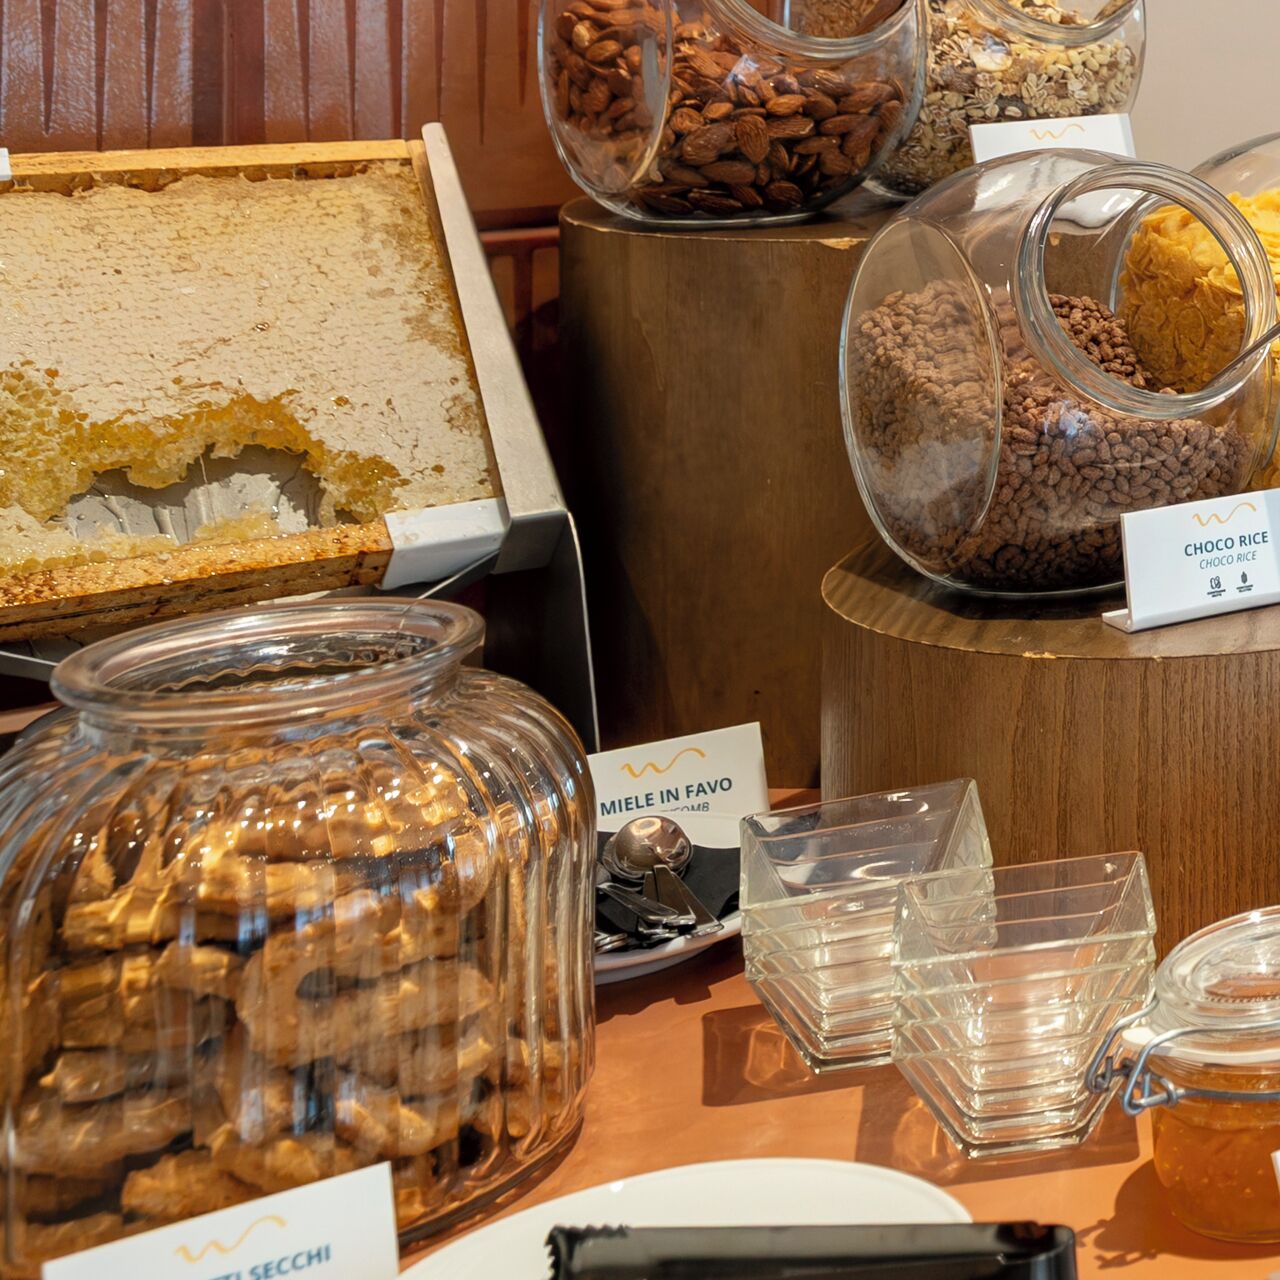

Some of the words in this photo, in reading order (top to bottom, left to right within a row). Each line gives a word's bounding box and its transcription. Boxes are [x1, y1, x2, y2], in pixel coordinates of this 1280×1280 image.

[1184, 537, 1235, 556] CHOCO
[1239, 531, 1269, 547] RICE
[1199, 554, 1234, 570] CHOCO
[1236, 550, 1257, 563] RICE
[600, 792, 655, 816] MIELE
[660, 787, 680, 804] IN
[686, 777, 733, 799] FAVO
[248, 1243, 332, 1280] SECCHI
